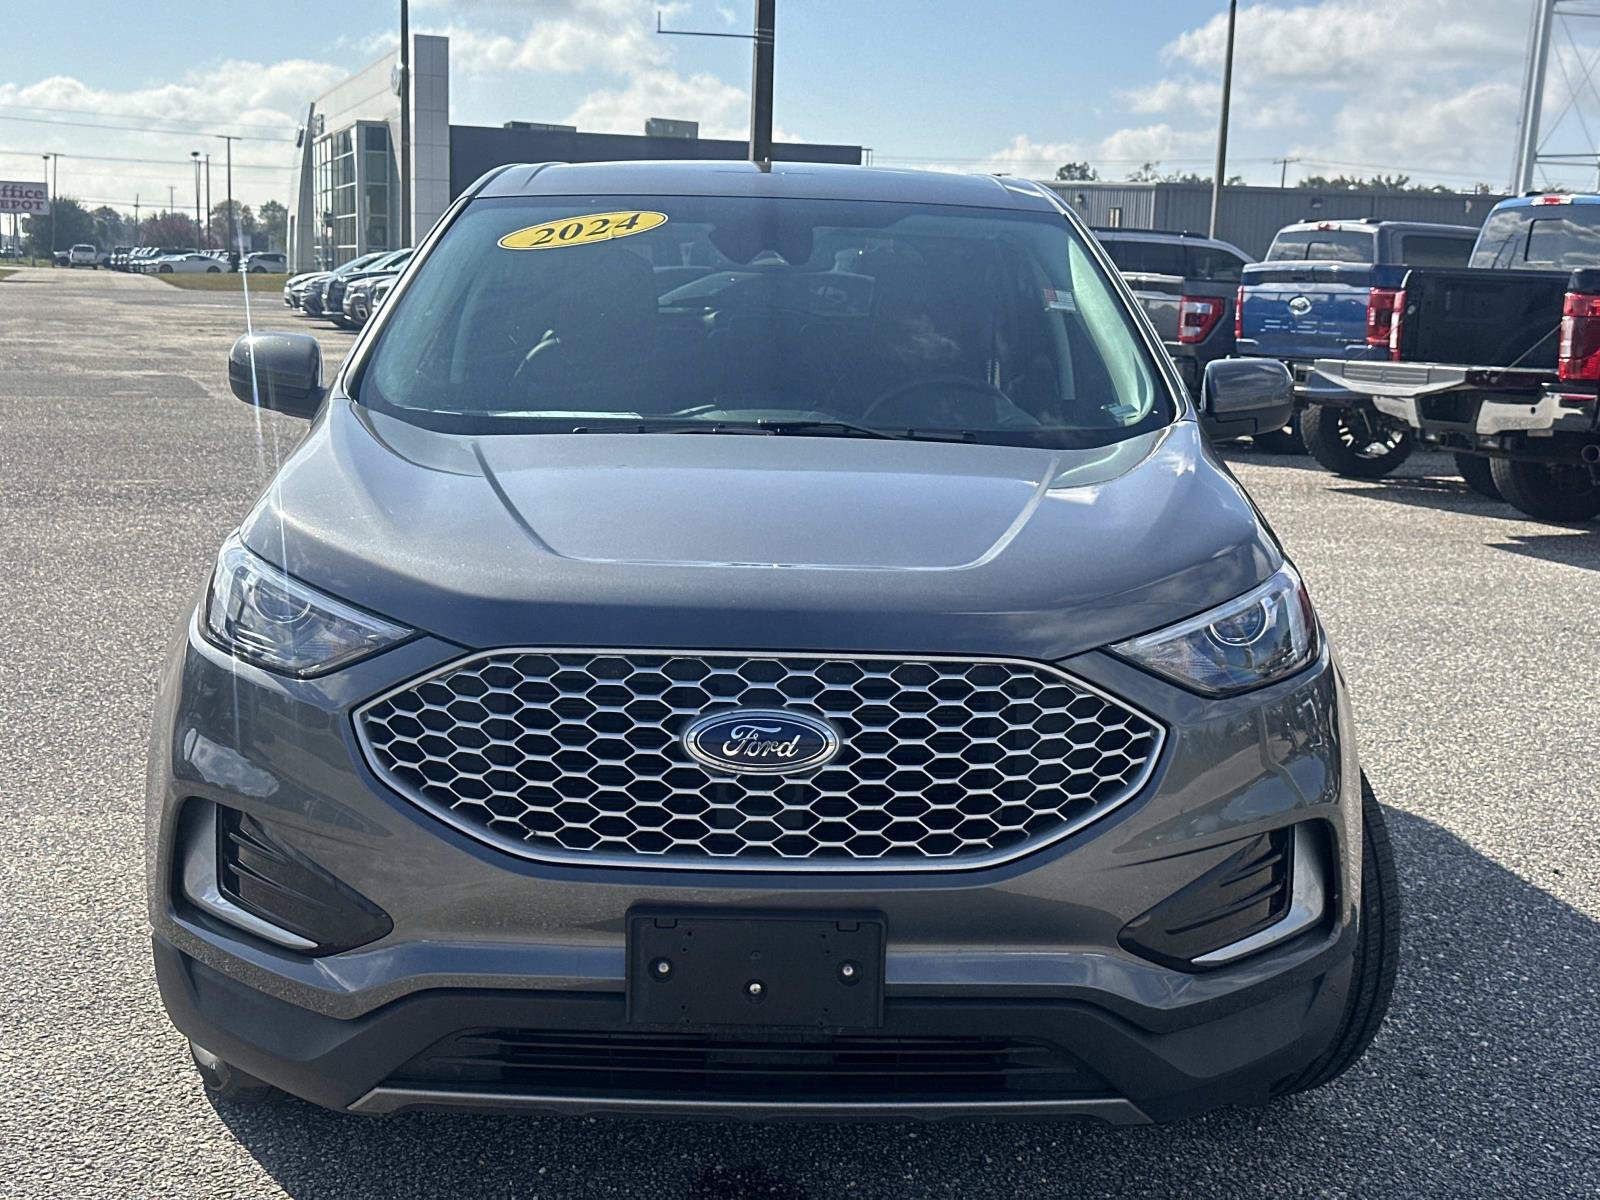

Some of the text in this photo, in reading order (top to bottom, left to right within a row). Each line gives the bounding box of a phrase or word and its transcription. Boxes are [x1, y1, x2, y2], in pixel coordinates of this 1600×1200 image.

[0, 184, 44, 199] ffice
[0, 199, 44, 210] EPOT
[530, 213, 641, 246] 2024
[722, 725, 801, 757] Ford
